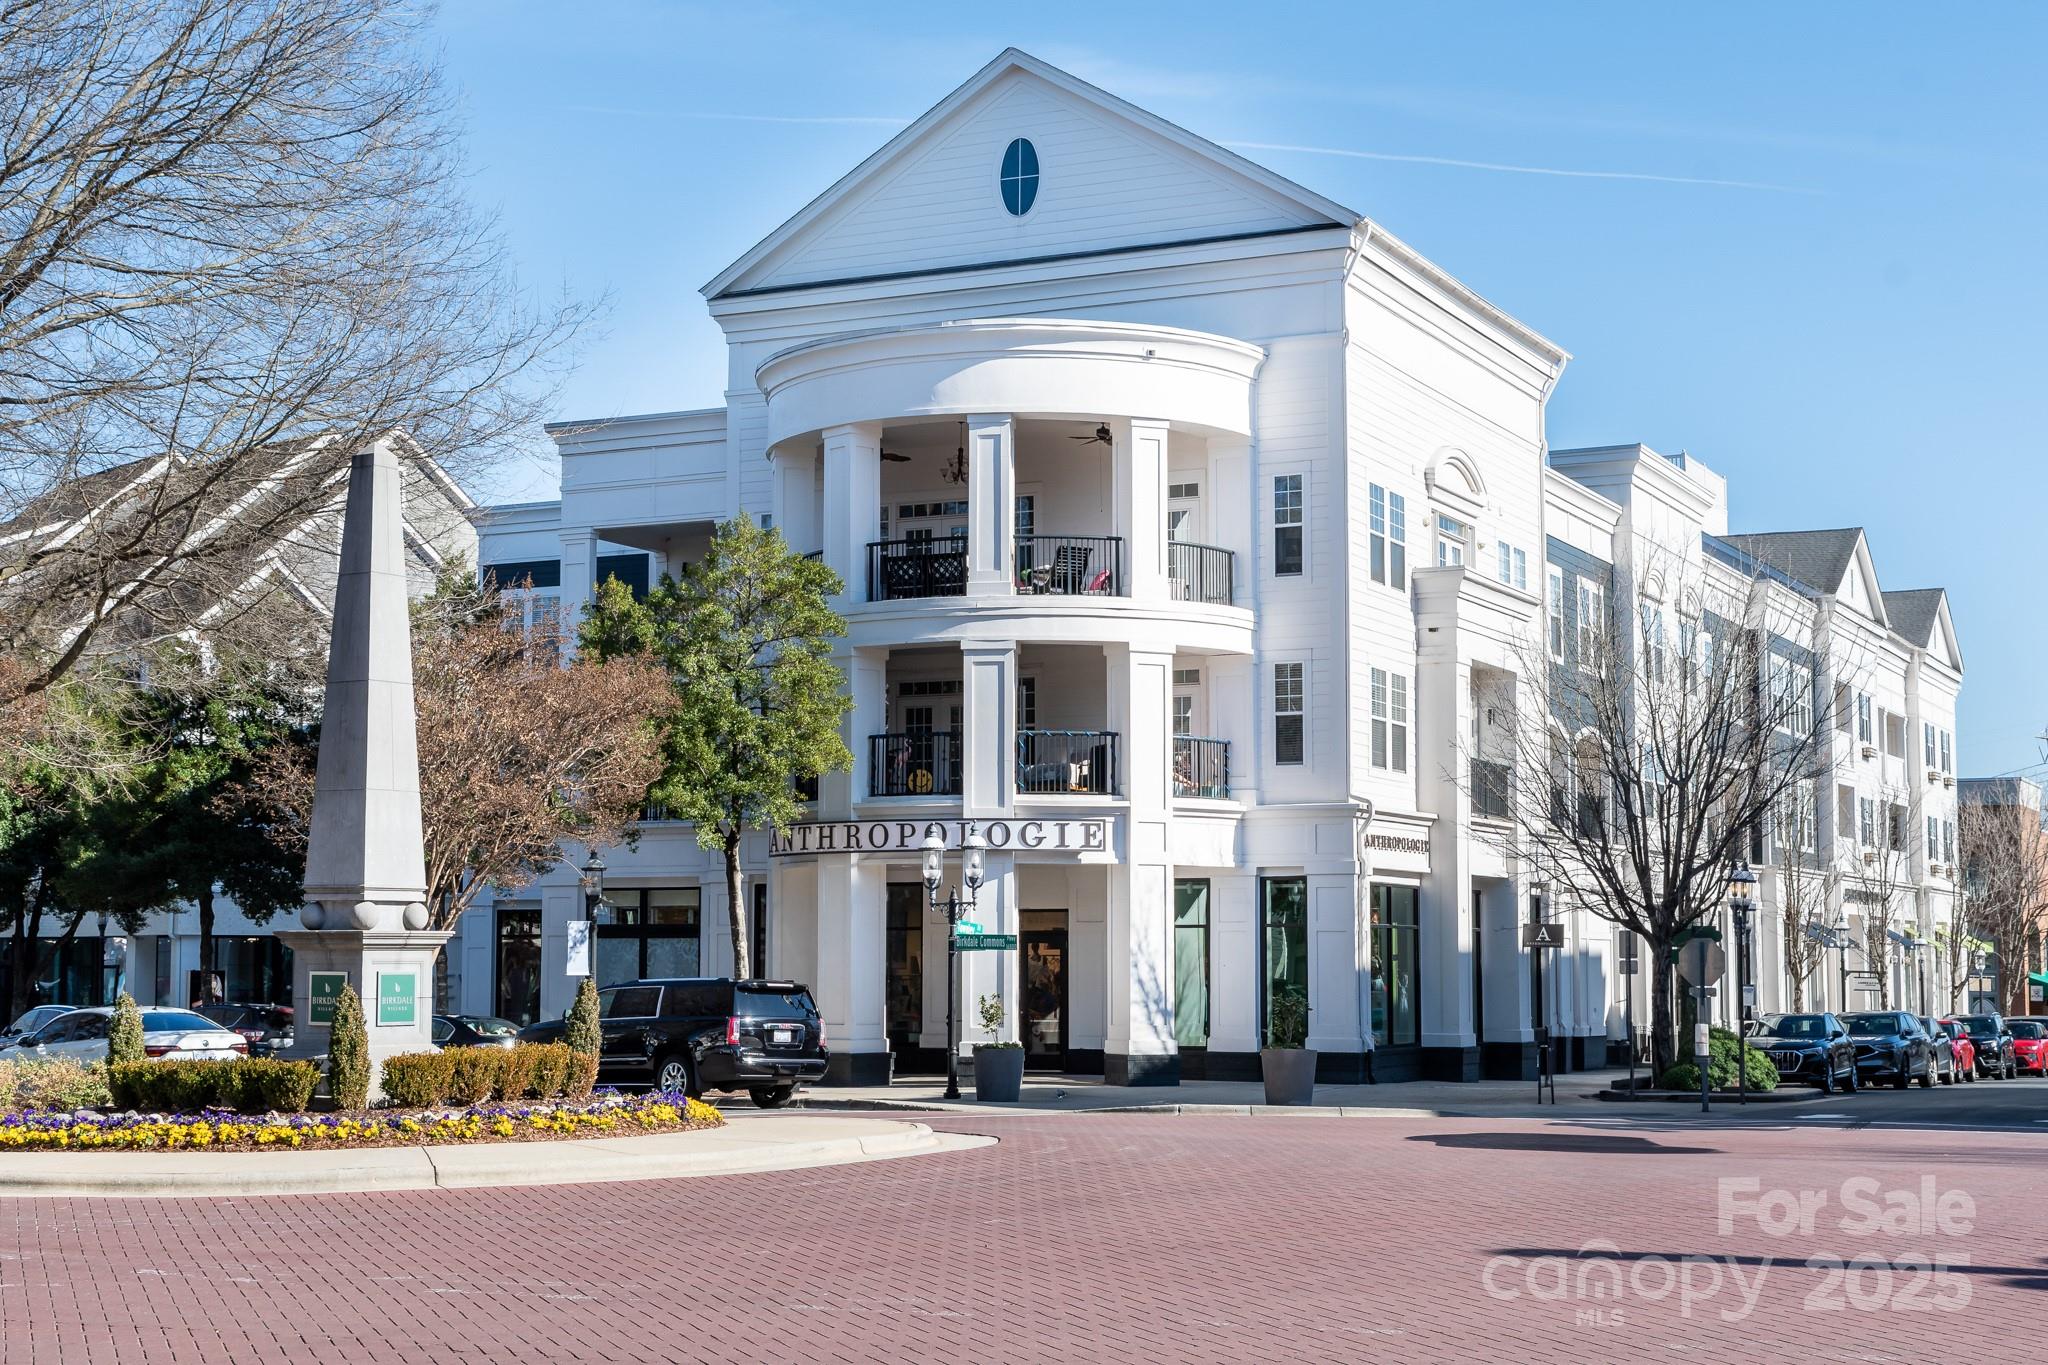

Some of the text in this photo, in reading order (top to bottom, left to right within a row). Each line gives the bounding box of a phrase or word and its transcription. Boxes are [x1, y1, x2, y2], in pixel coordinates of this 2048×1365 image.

[1364, 834, 1429, 852] ANTHROPOLOGIE
[1536, 926, 1552, 941] A
[956, 935, 978, 947] Birkdale
[980, 935, 1005, 947] Commons
[312, 997, 337, 1005] BIRKDA
